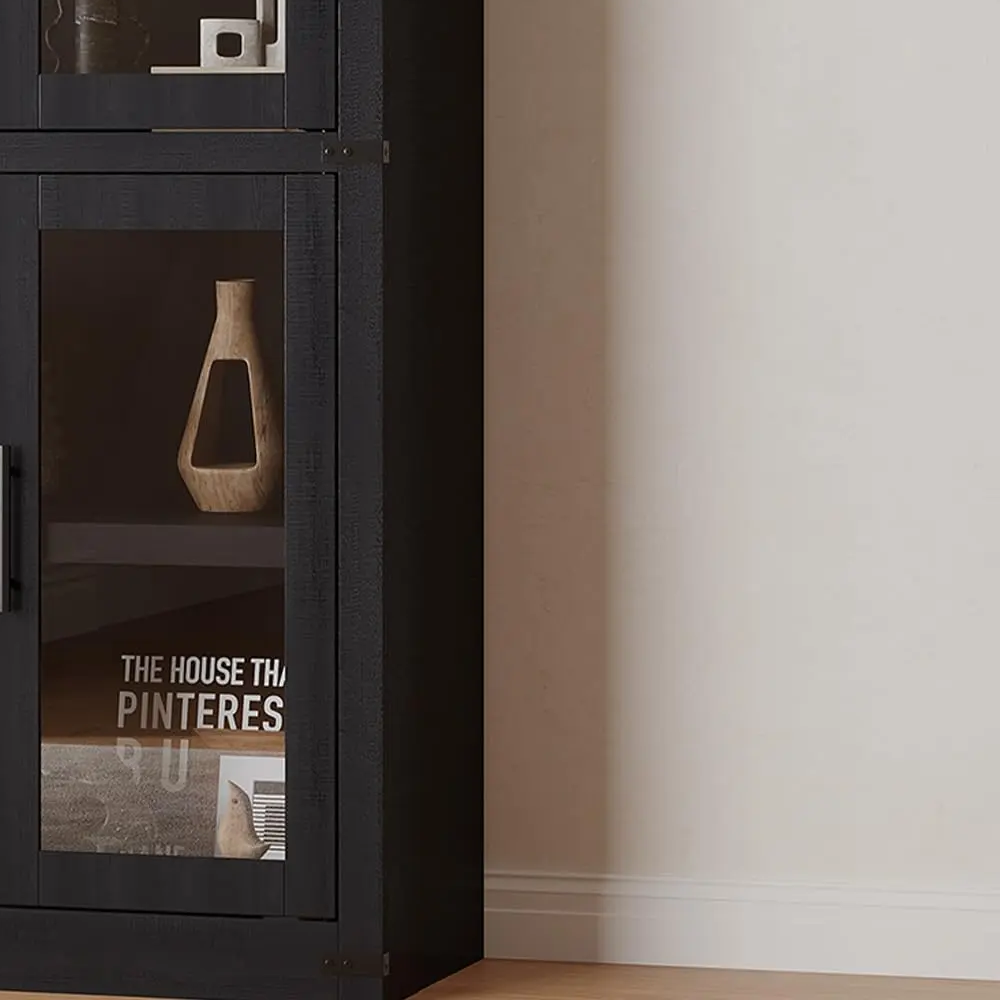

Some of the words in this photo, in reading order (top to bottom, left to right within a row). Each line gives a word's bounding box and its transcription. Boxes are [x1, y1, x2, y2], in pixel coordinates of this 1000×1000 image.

[121, 654, 164, 683] THE
[170, 656, 245, 687] HOUSE
[116, 690, 284, 732] PINTERES
